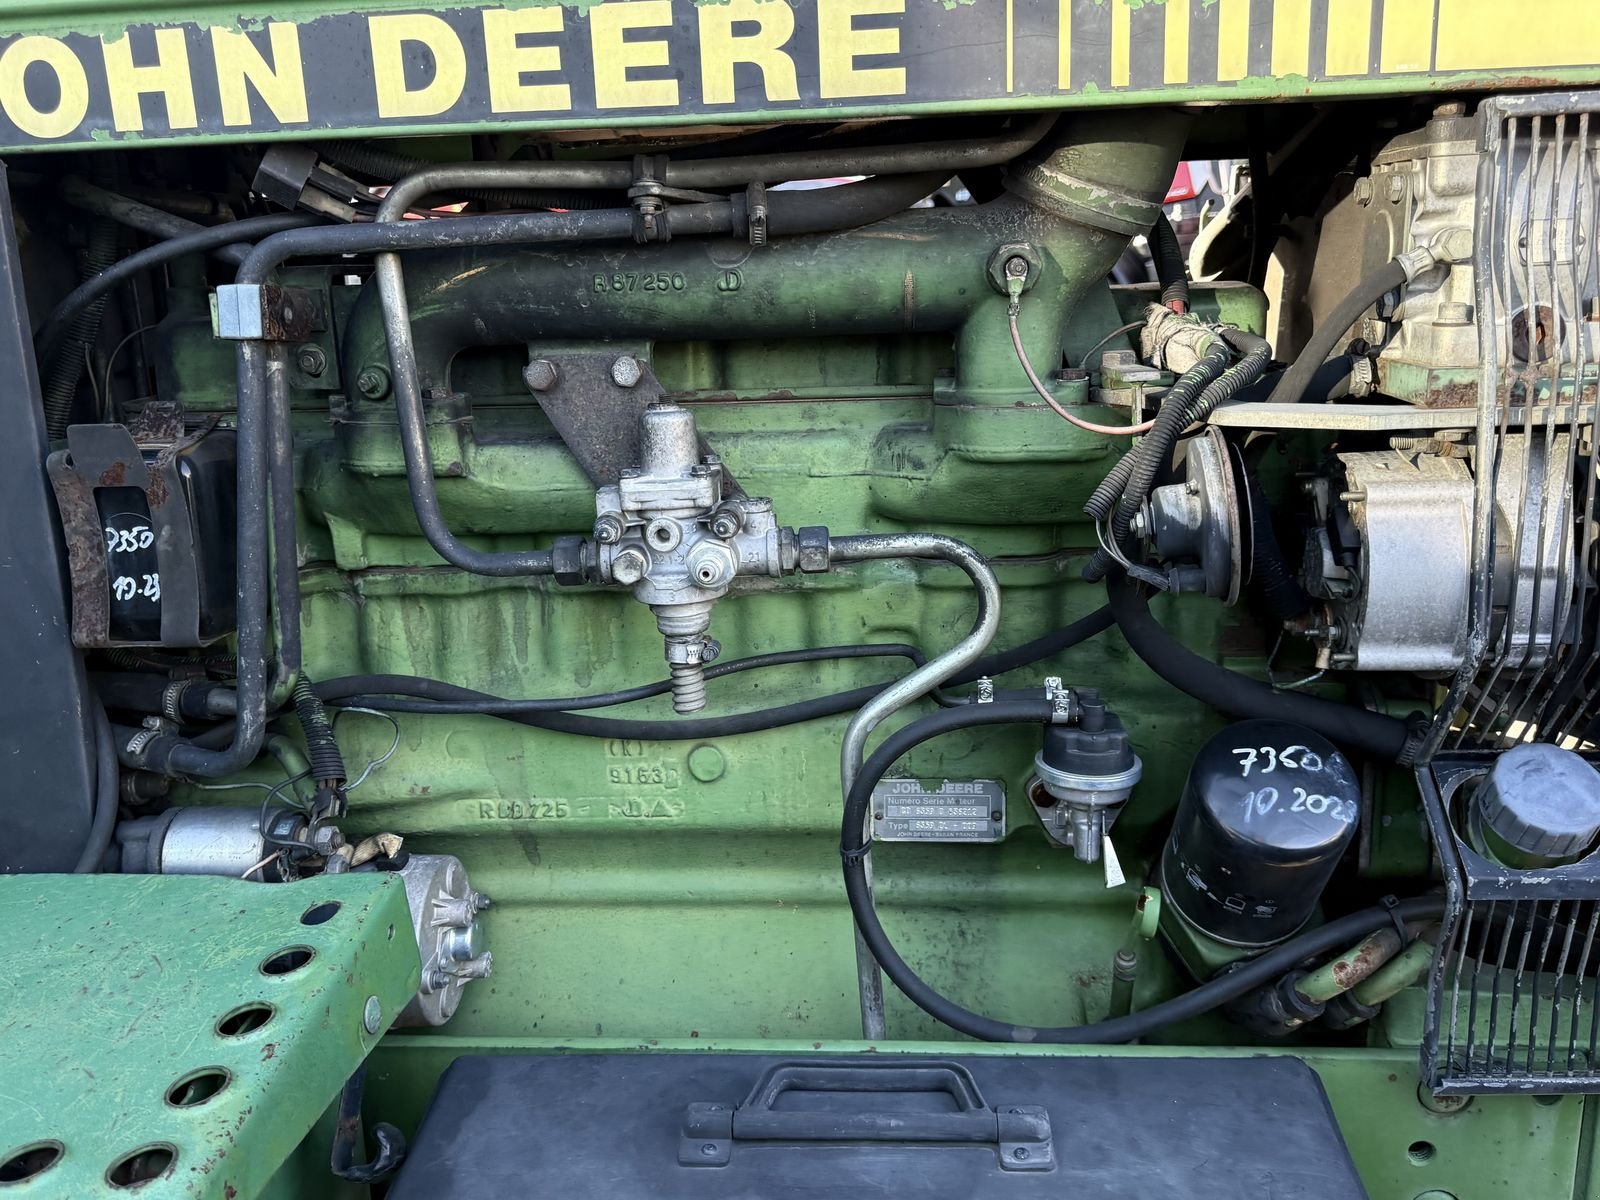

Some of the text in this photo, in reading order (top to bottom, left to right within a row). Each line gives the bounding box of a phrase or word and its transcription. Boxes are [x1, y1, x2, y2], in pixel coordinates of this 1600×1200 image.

[368, 0, 907, 119] DEERE
[892, 783, 931, 794] JOH
[947, 797, 976, 805] Mteur
[888, 822, 909, 831] Type
